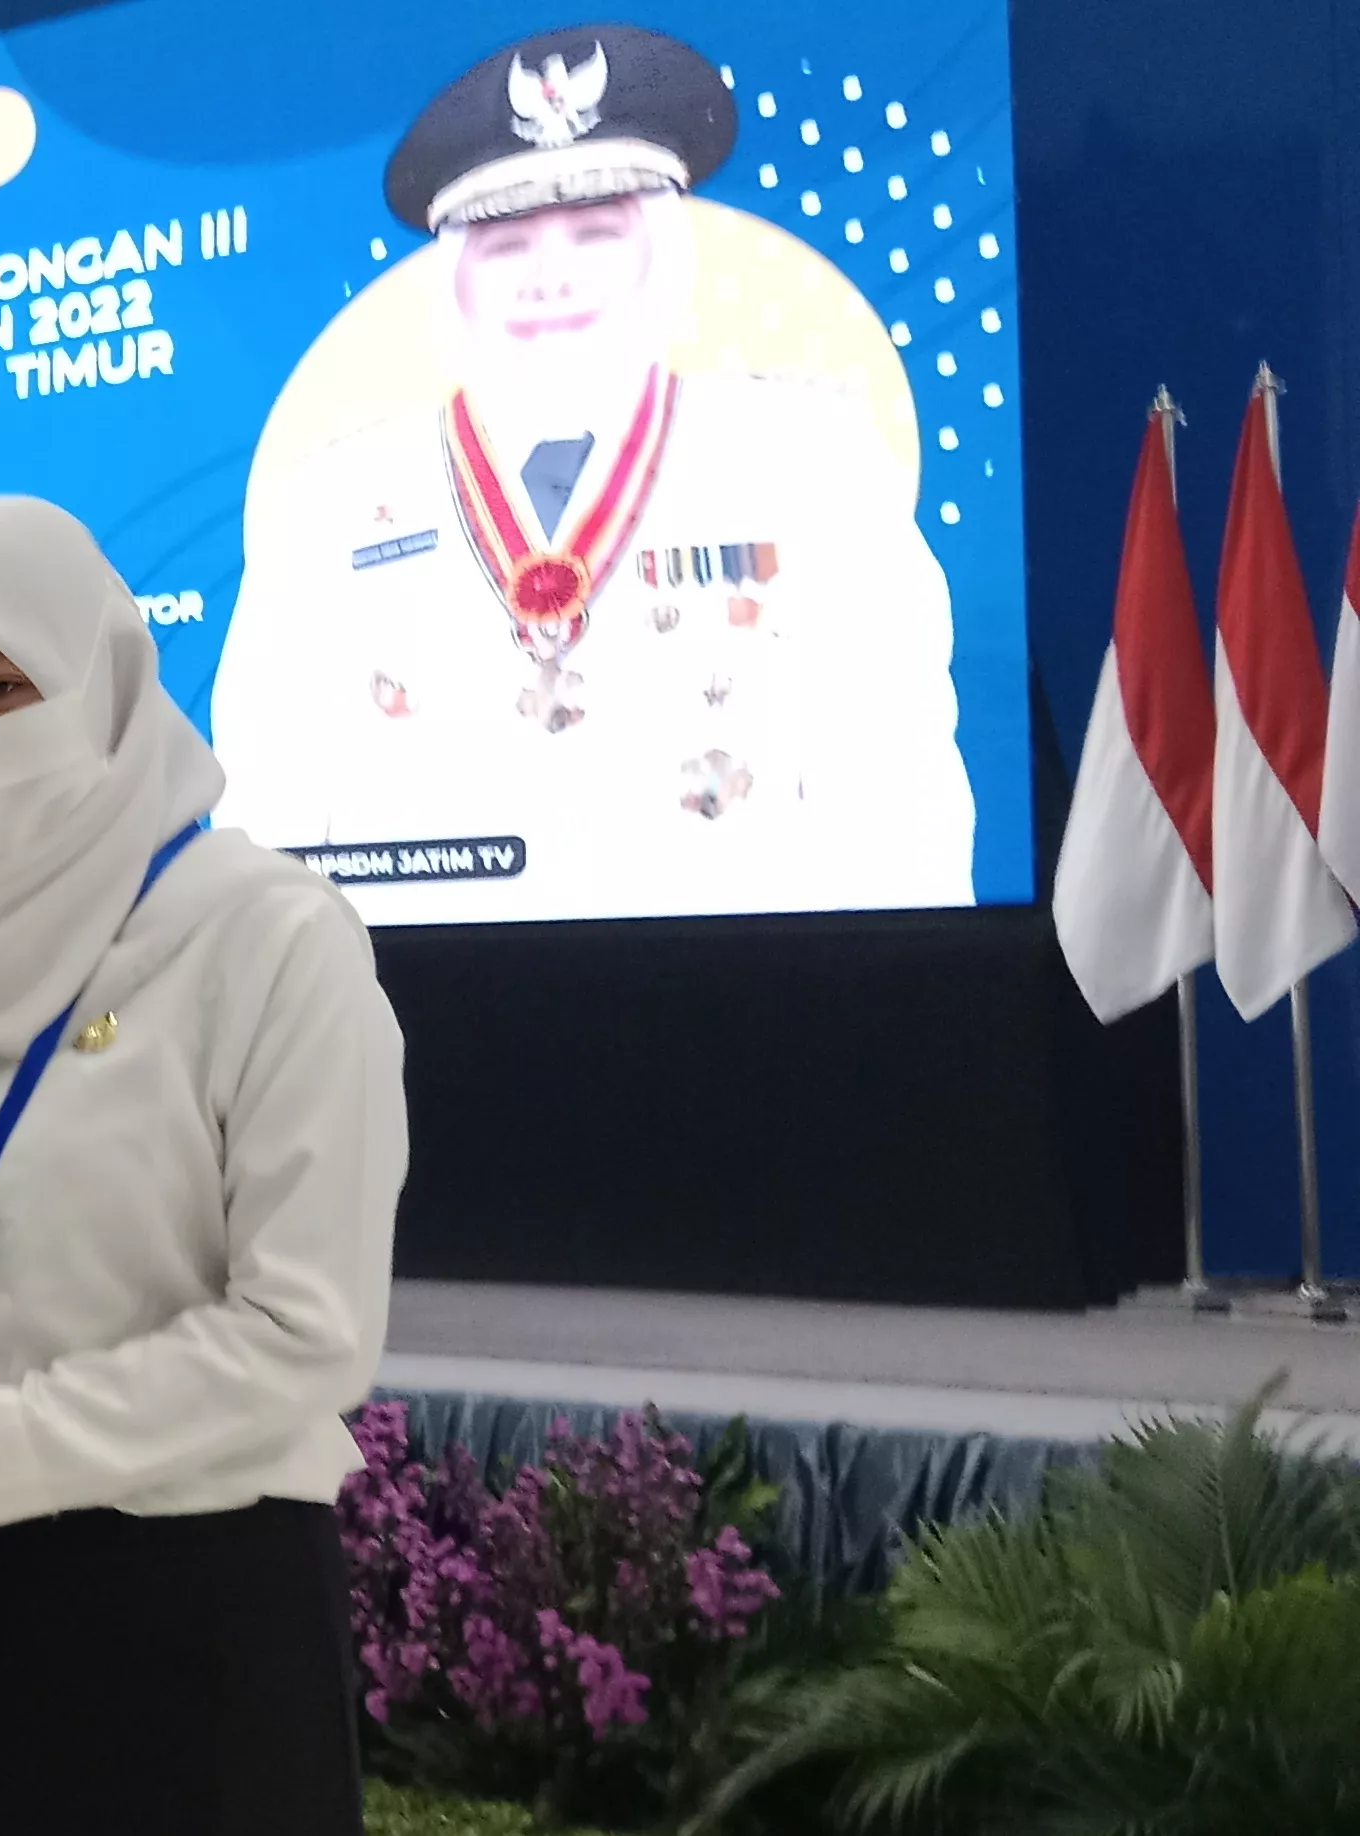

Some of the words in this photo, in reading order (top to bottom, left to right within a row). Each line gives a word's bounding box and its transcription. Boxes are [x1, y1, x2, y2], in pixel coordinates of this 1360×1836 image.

[200, 205, 247, 260] III
[29, 279, 153, 345] 2022
[6, 330, 173, 399] TIMUR
[397, 846, 474, 874] JATIM
[477, 844, 515, 870] TV
